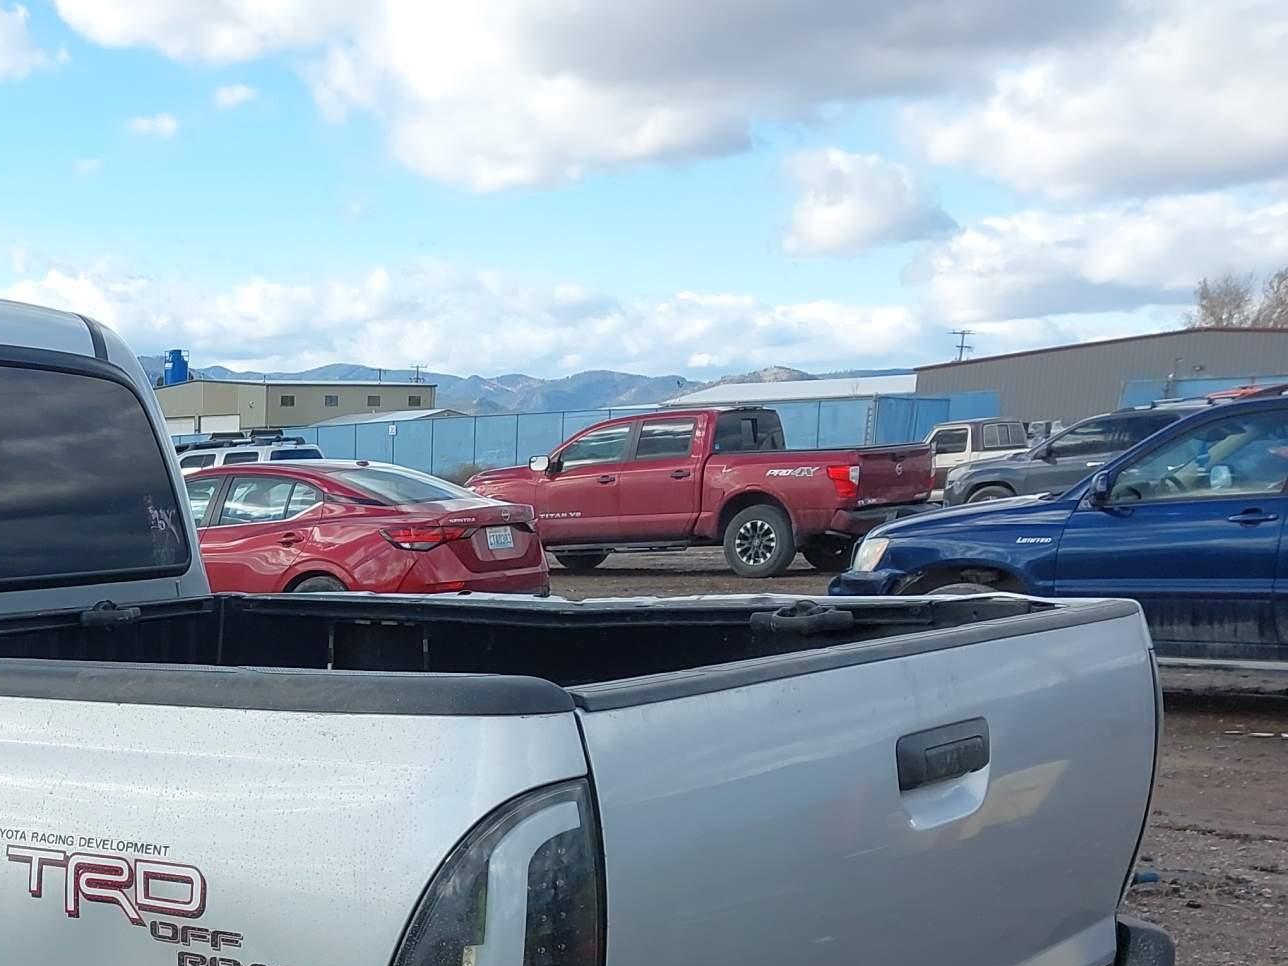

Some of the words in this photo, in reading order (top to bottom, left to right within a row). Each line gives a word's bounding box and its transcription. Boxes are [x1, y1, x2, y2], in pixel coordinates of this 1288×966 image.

[30, 832, 75, 846] RACING
[78, 837, 170, 857] DEVELOPMENT
[6, 844, 208, 927] TRD
[150, 920, 244, 951] OFF
